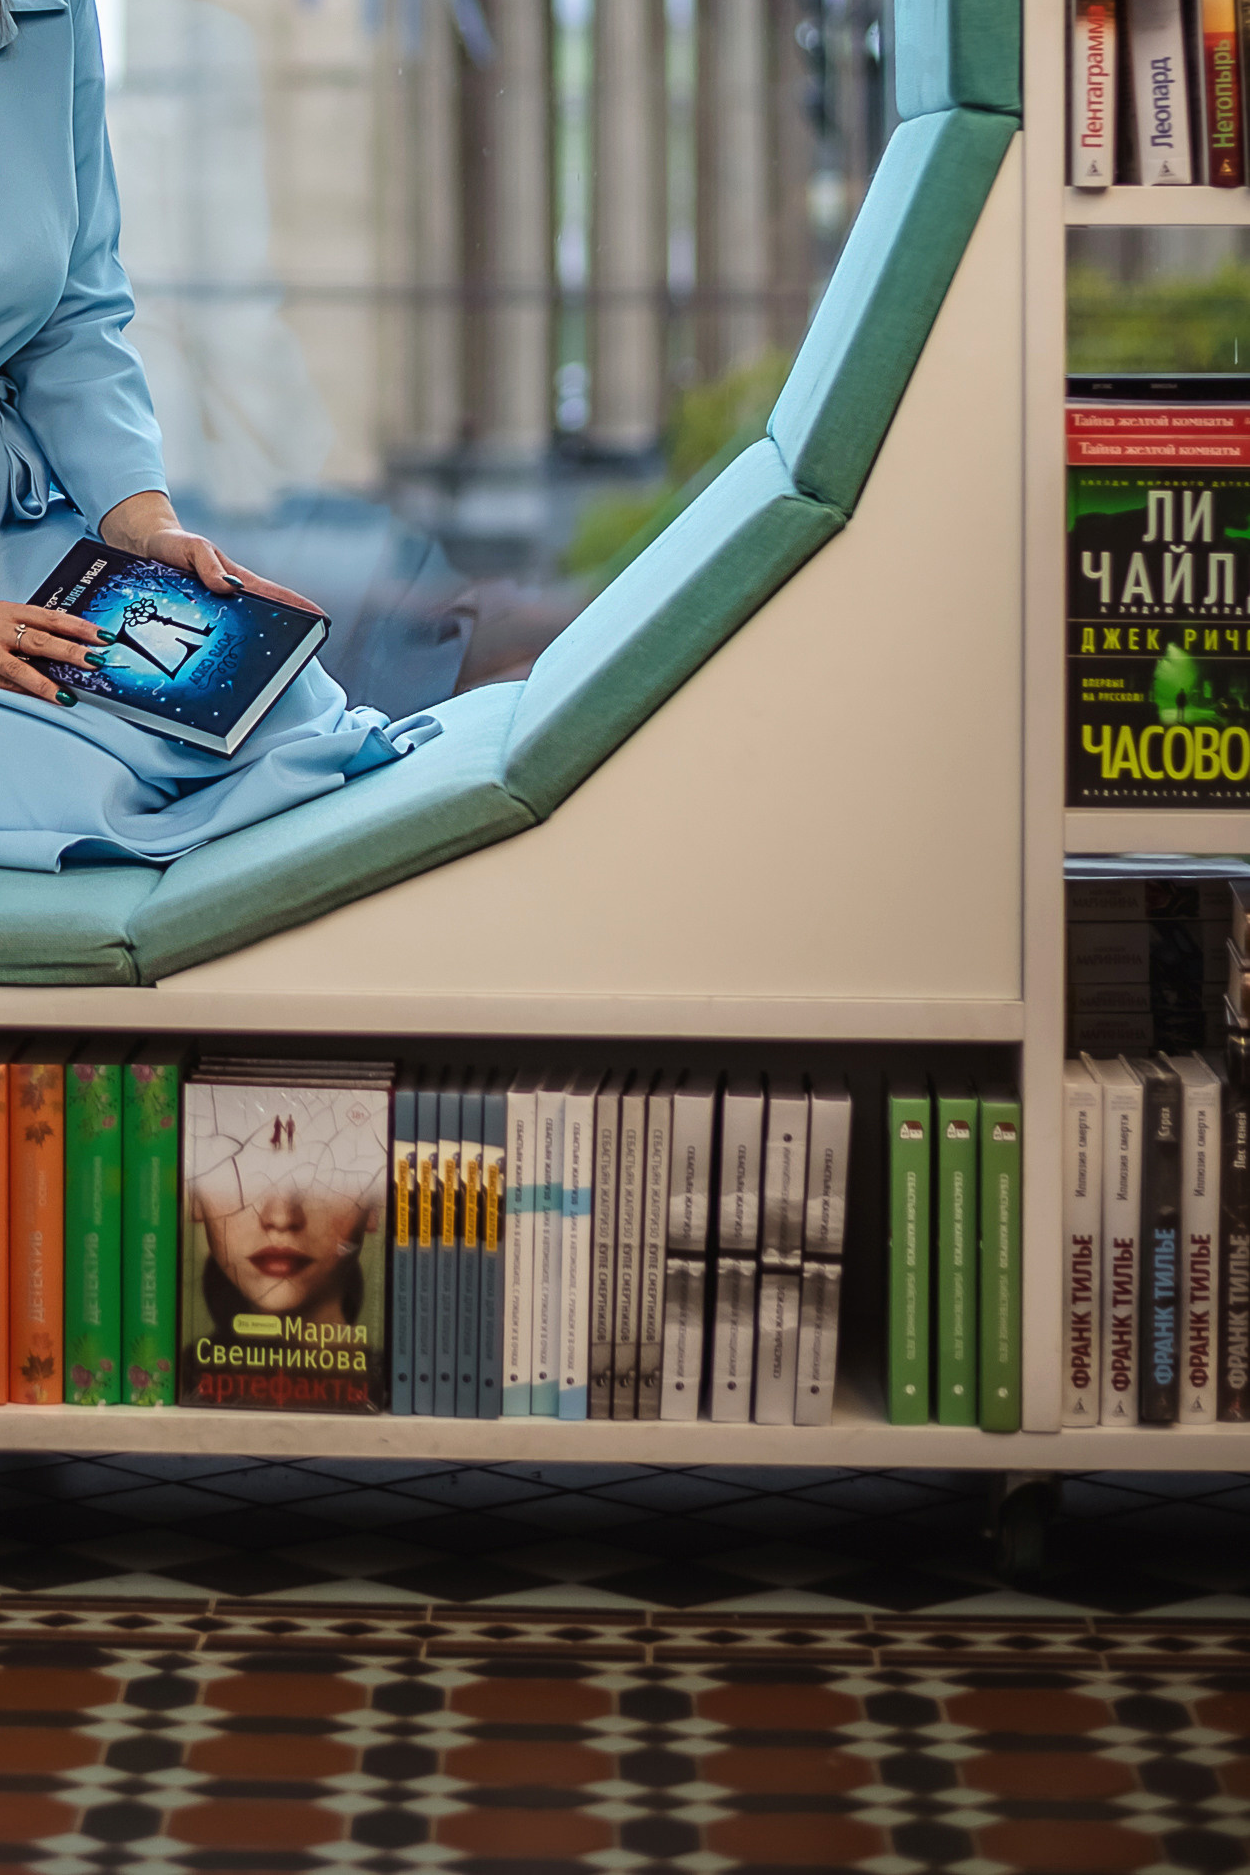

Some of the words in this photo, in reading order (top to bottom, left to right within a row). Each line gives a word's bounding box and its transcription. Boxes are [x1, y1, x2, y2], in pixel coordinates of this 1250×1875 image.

[1146, 57, 1174, 149] Леопард
[1209, 39, 1235, 148] Нетопырь
[1072, 413, 1115, 426] Тайна
[1119, 415, 1169, 427] желтой
[1172, 418, 1234, 427] комнаты
[1079, 442, 1121, 455] Тайна
[1126, 444, 1176, 455] желтой
[1179, 447, 1241, 456] комнаты
[1142, 490, 1213, 543] ЛИ
[1081, 543, 1250, 605] ЧАЙЛ
[1081, 627, 1160, 653] ДЖЕК
[1184, 629, 1250, 651] РИЧ
[1082, 725, 1250, 781] ЧАСОВО
[1075, 1111, 1089, 1148] смерти
[1117, 1114, 1131, 1151] смерти
[1157, 1107, 1172, 1137] Страх
[1195, 1110, 1208, 1147] смерти
[599, 1128, 612, 1185] СЕБАСТЬЯН
[624, 1129, 637, 1186] СЕБАСТЬЯН
[651, 1129, 663, 1186] СЕБАСТЬЯН
[1074, 1152, 1088, 1197] Иллюзия
[1116, 1155, 1130, 1201] Иллюзия
[1193, 1151, 1207, 1197] Иллюзия
[598, 1188, 610, 1238] ЖАПРИЗО
[622, 1188, 635, 1239] ЖАПРИЗО
[648, 1188, 661, 1239] ЖАПРИЗО
[597, 1242, 609, 1269] КУПЕ
[622, 1243, 633, 1269] КУПЕ
[647, 1243, 659, 1269] КУПЕ
[1071, 1234, 1093, 1304] ТИЛЬЕ
[1112, 1238, 1134, 1307] ТИЛЬЕ
[1153, 1228, 1175, 1299] ТИЛЬЕ
[1189, 1234, 1211, 1304] ТИЛЬЕ
[1228, 1234, 1250, 1304] ТИЛЬЕ
[285, 1316, 368, 1346] Мария
[596, 1272, 607, 1342] СМЕРТНИКОВ
[619, 1272, 632, 1342] СМЕРТНИКОВ
[646, 1272, 658, 1342] СМЕРТНИКОВ
[197, 1337, 367, 1372] Свешникова
[1071, 1312, 1093, 1389] ФРАНК
[1111, 1315, 1134, 1392] ФРАНК
[1153, 1307, 1175, 1385] ФРАНК
[1189, 1311, 1210, 1388] ФРАНК
[1227, 1311, 1250, 1389] ФРАНК
[197, 1368, 369, 1406] артефакты
